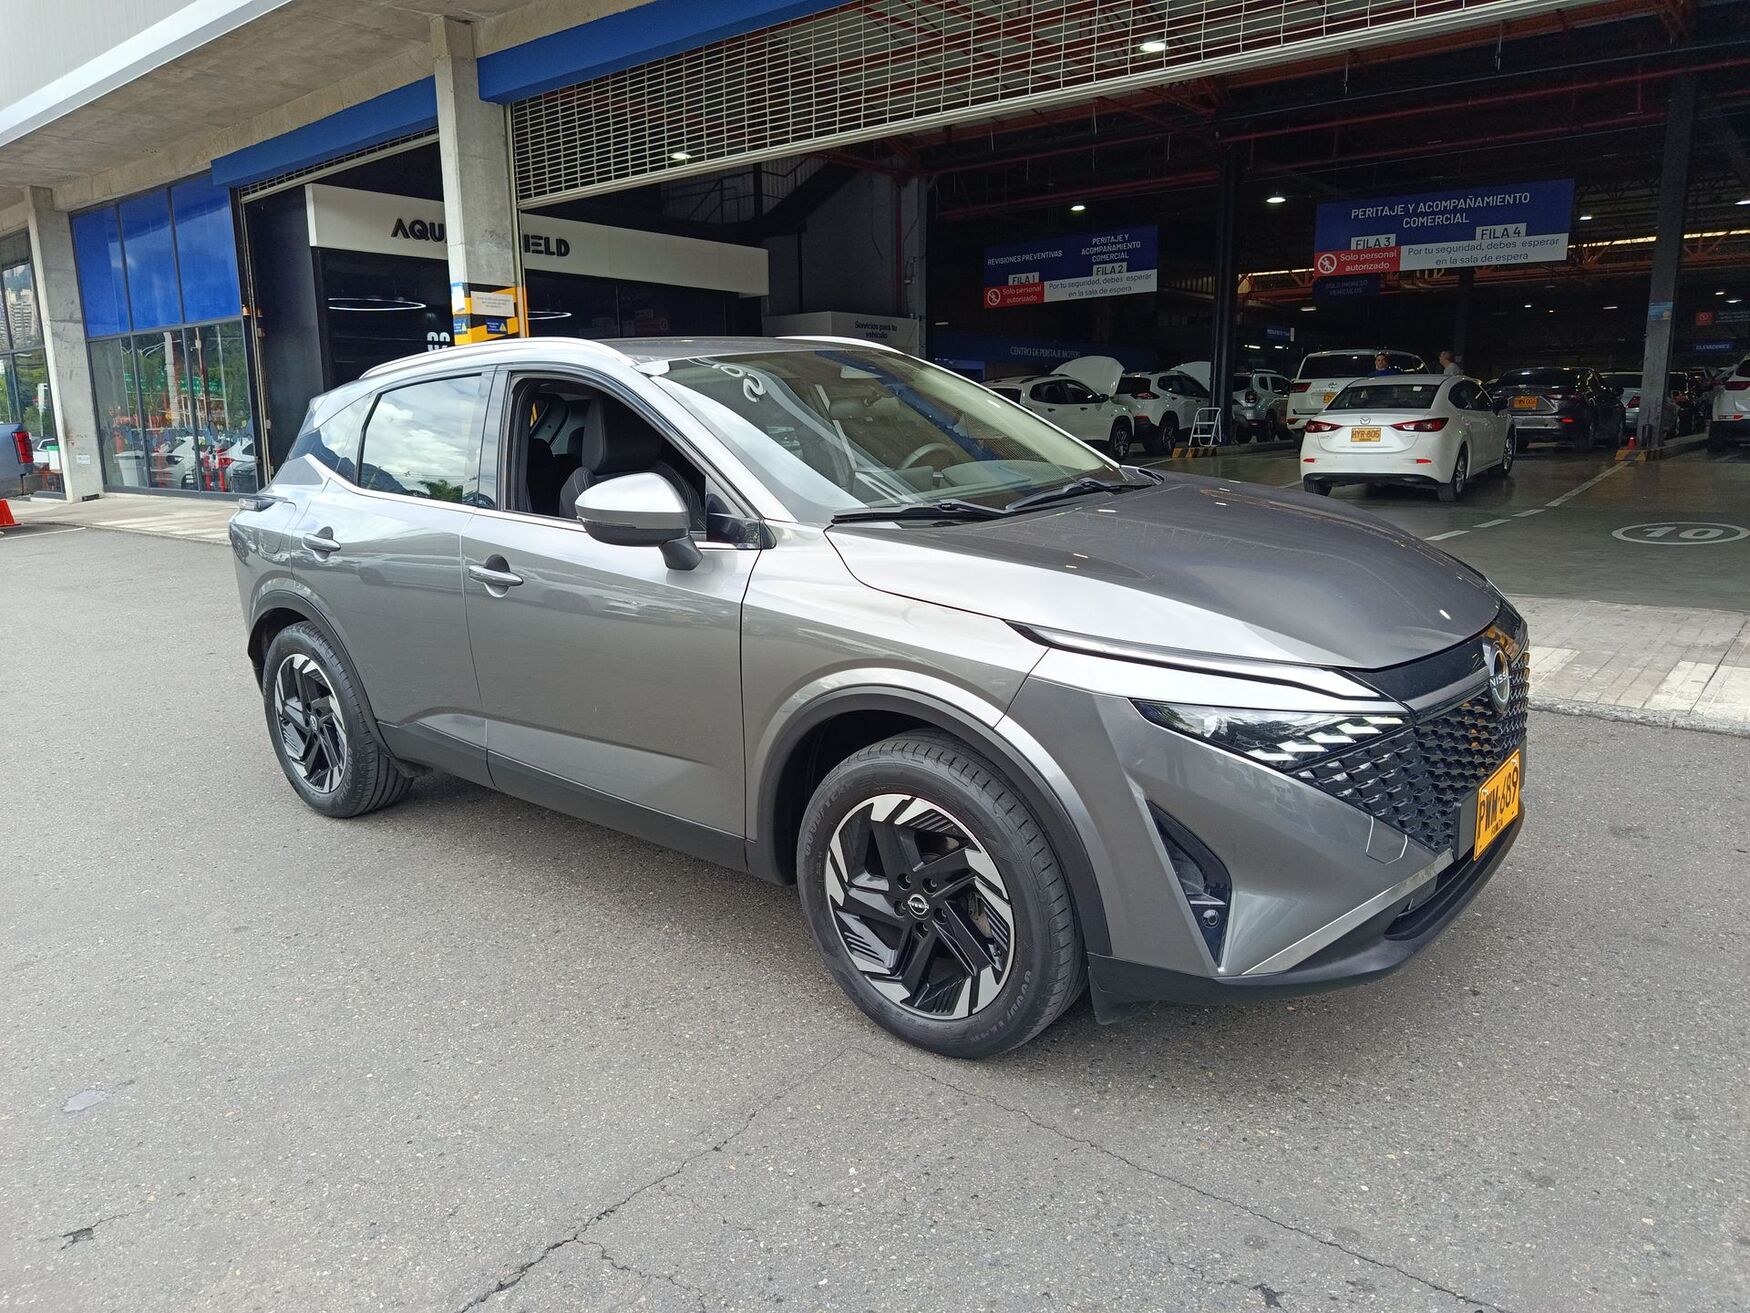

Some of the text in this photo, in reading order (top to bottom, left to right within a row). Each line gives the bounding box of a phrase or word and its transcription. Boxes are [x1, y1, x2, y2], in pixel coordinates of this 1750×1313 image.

[1351, 192, 1530, 220] PERITAJE Y ACOMPAÑAMIENTO
[1402, 213, 1470, 229] COMERCIAL
[390, 217, 571, 257] AQU IELD
[1092, 233, 1130, 246] PERITAJE Y
[1480, 226, 1521, 241] FILA 4
[1080, 241, 1141, 256] ACOMPAÑAMIENTO
[1355, 237, 1391, 250] FILA 3
[1407, 238, 1560, 256] Por tu seguridad, debes esperar
[987, 250, 1063, 266] REVISIONES PREVENTIVAS
[1092, 251, 1130, 263] COMERCIAL
[1339, 250, 1397, 262] Solo personal
[1435, 253, 1529, 266] en la sala de espera
[1096, 264, 1124, 276] FILA 2
[1345, 261, 1390, 272] autorizado
[1012, 275, 1030, 284] FILA
[1060, 281, 1067, 289] tu
[1102, 275, 1123, 284] debes
[1002, 285, 1042, 296] Solo personal
[1099, 287, 1109, 295] de
[1643, 526, 1724, 539] 10
[1489, 671, 1508, 687] NISS
